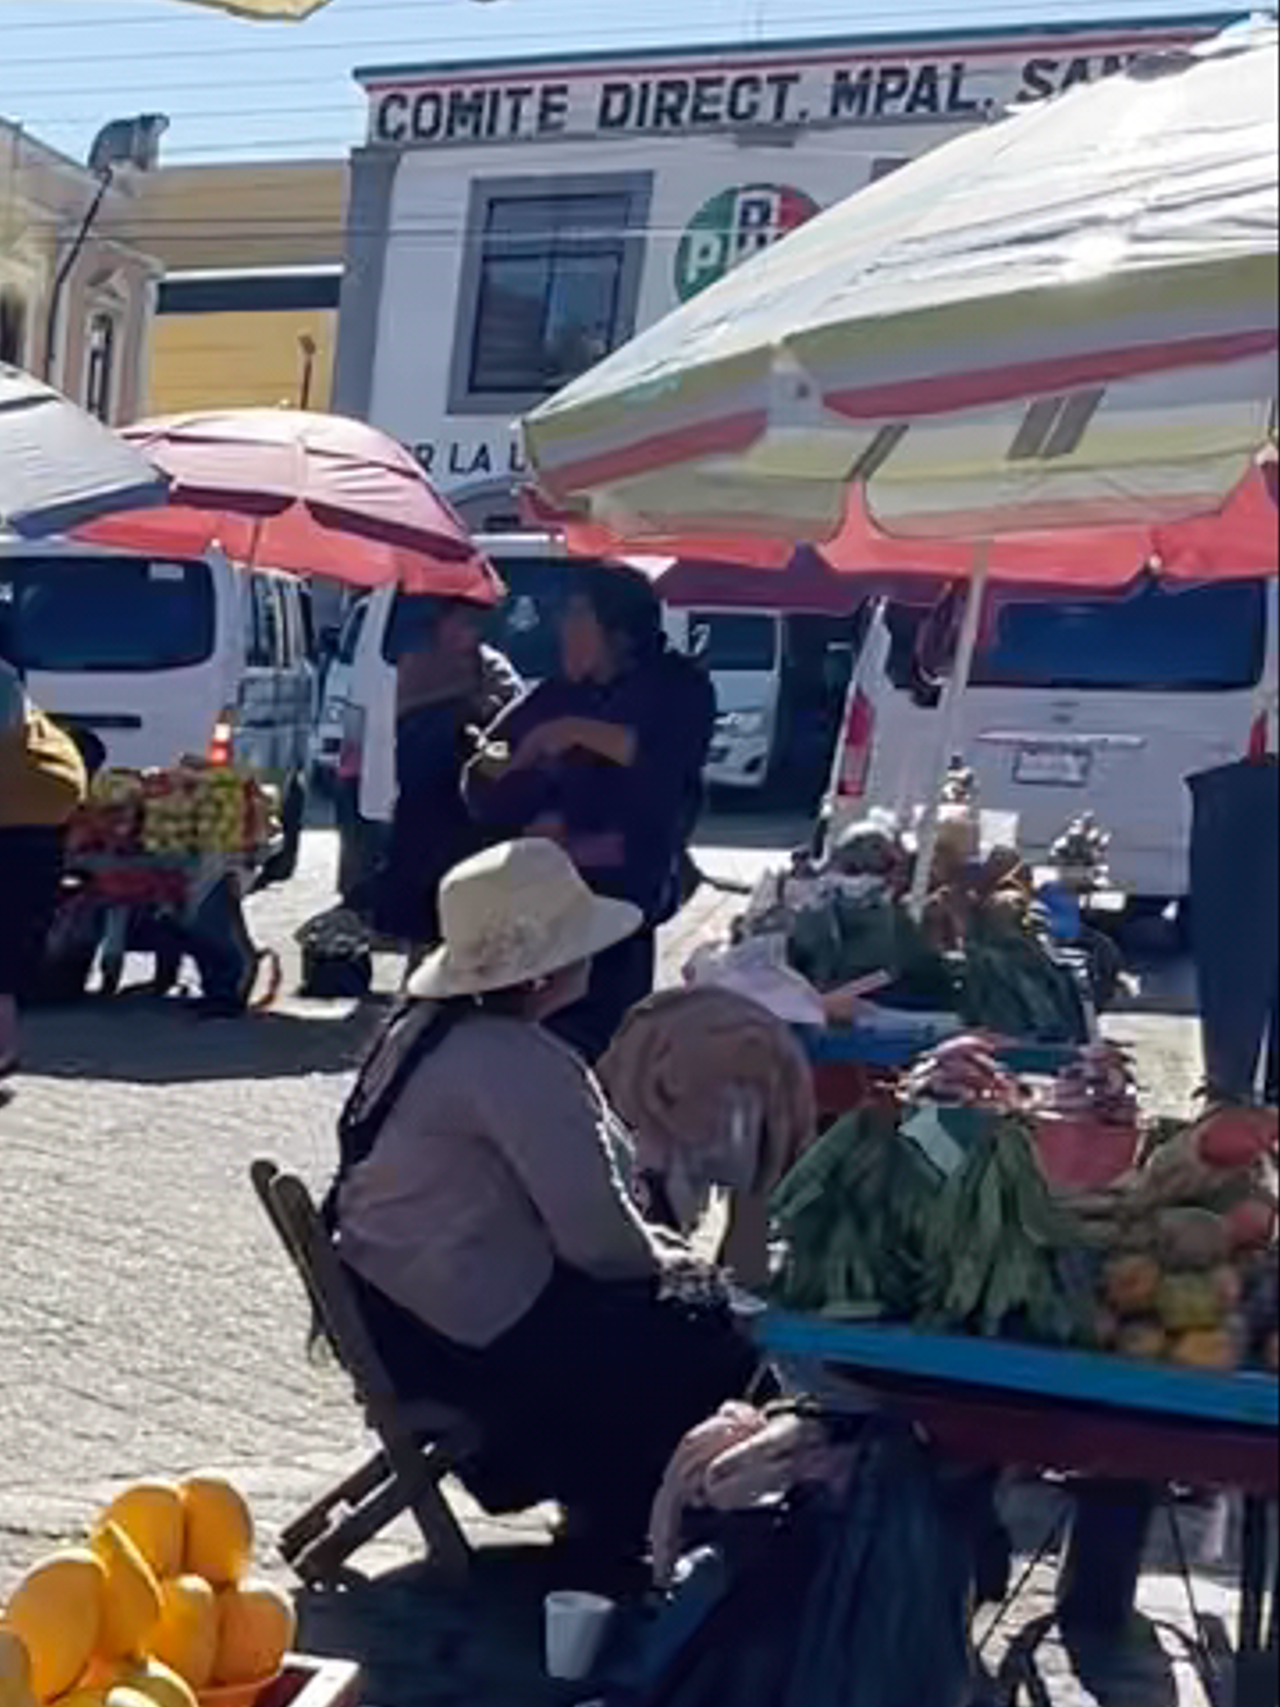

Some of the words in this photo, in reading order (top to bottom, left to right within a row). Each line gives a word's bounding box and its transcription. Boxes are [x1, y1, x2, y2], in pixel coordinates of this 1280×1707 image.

[374, 83, 570, 142] COMITE
[829, 61, 993, 118] MPAL.
[449, 442, 491, 474] LA
